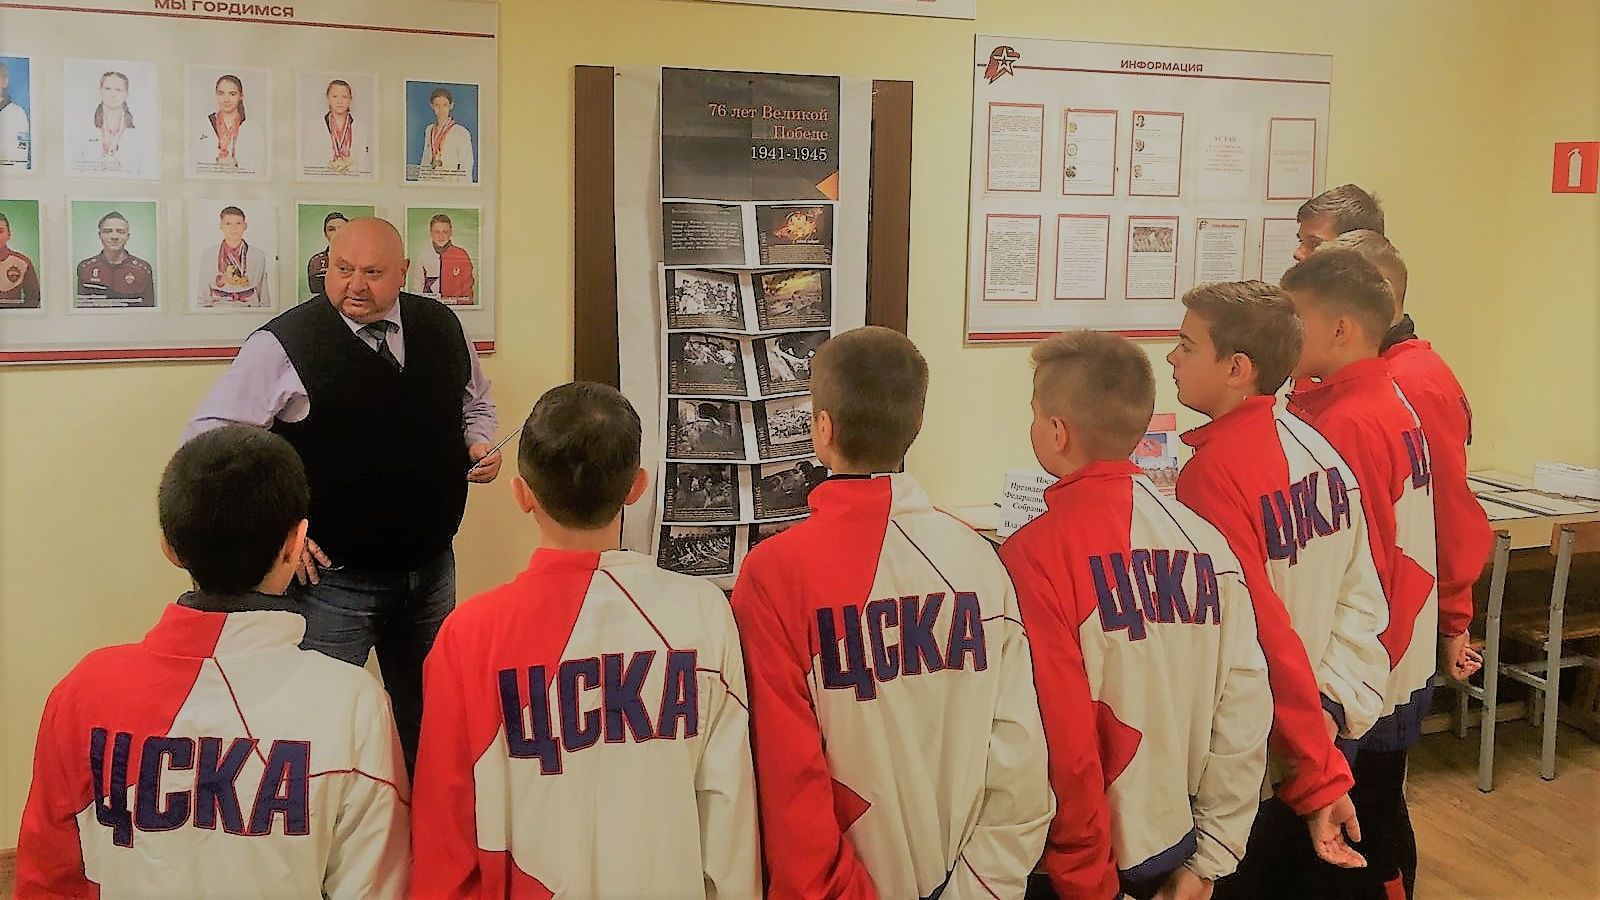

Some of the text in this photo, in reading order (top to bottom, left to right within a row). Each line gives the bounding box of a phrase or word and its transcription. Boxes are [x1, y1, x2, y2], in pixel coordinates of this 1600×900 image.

[155, 0, 294, 18] МЫ ГОРДИМСЯ
[1120, 60, 1203, 73] ИНФОРМАЦИЯ
[709, 102, 829, 121] 76 лет Великой
[774, 124, 829, 140] Победе
[751, 146, 828, 160] 1941-1945
[1260, 467, 1351, 568] ЦСКА
[1088, 549, 1221, 642] ЦСКА
[816, 592, 988, 702] ЦСКА
[499, 649, 699, 776] ЦСКА
[90, 727, 311, 849] ЦСКА
